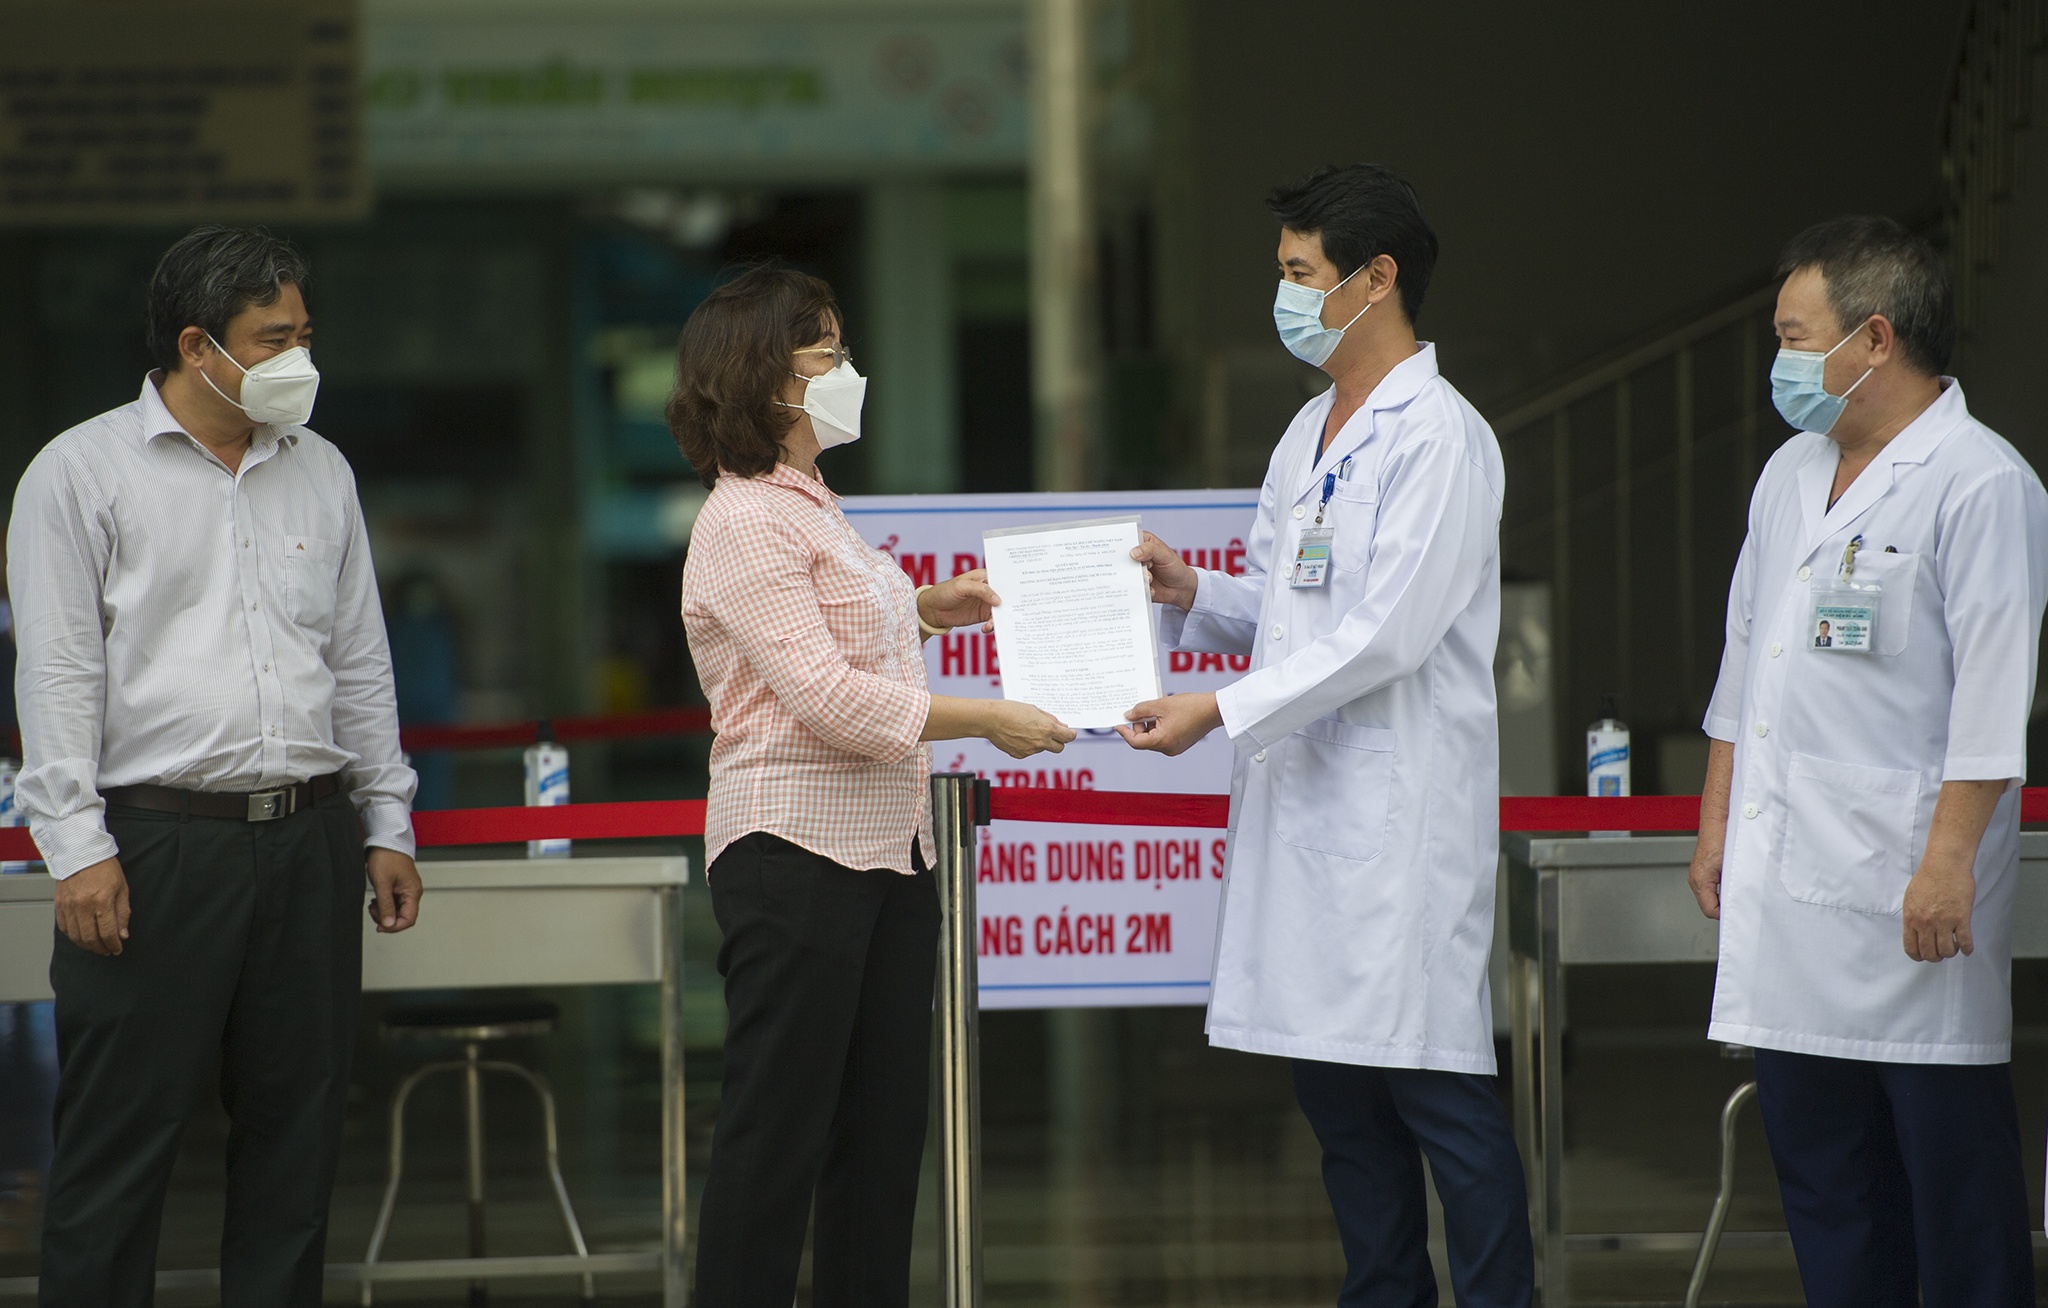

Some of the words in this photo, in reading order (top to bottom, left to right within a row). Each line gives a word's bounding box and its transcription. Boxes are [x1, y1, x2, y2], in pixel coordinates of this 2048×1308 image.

[1047, 842, 1123, 881] DUNG
[1135, 839, 1200, 889] DỊCH
[978, 915, 1022, 955] NG
[1035, 905, 1114, 954] CÁCH
[1126, 913, 1171, 953] 2M
